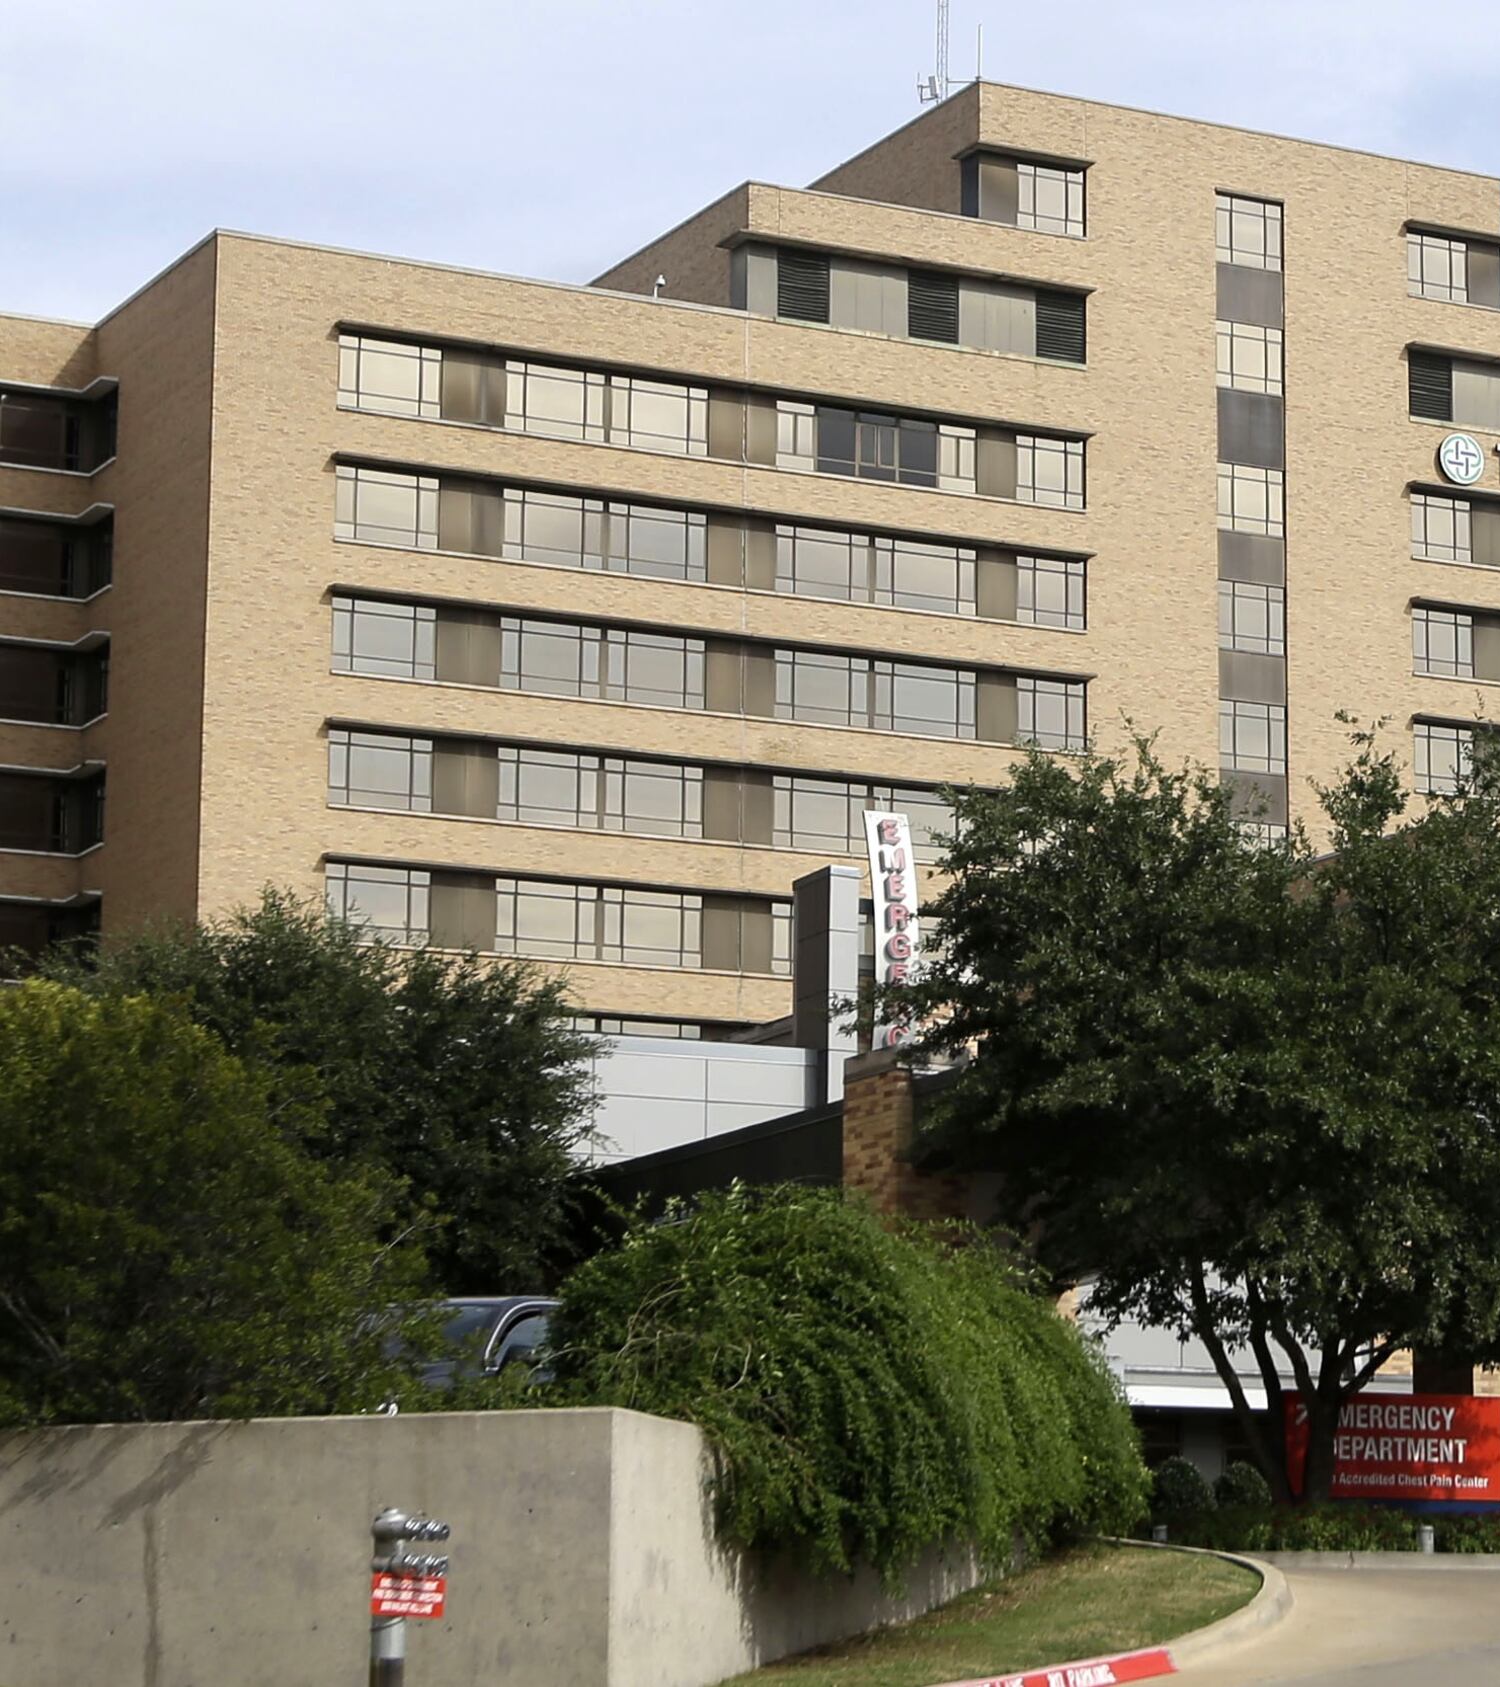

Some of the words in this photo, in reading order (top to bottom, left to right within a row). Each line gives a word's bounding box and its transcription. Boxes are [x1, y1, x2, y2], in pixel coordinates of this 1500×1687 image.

[878, 819, 911, 1047] EMERGEC
[1338, 1404, 1455, 1431] MERGENCY
[1334, 1436, 1467, 1463] EPARTMENT
[1339, 1472, 1395, 1485] Accredited
[1398, 1473, 1428, 1487] Chest
[1430, 1474, 1453, 1487] Pain
[1455, 1475, 1489, 1489] Center
[1067, 1664, 1116, 1687] PARKING
